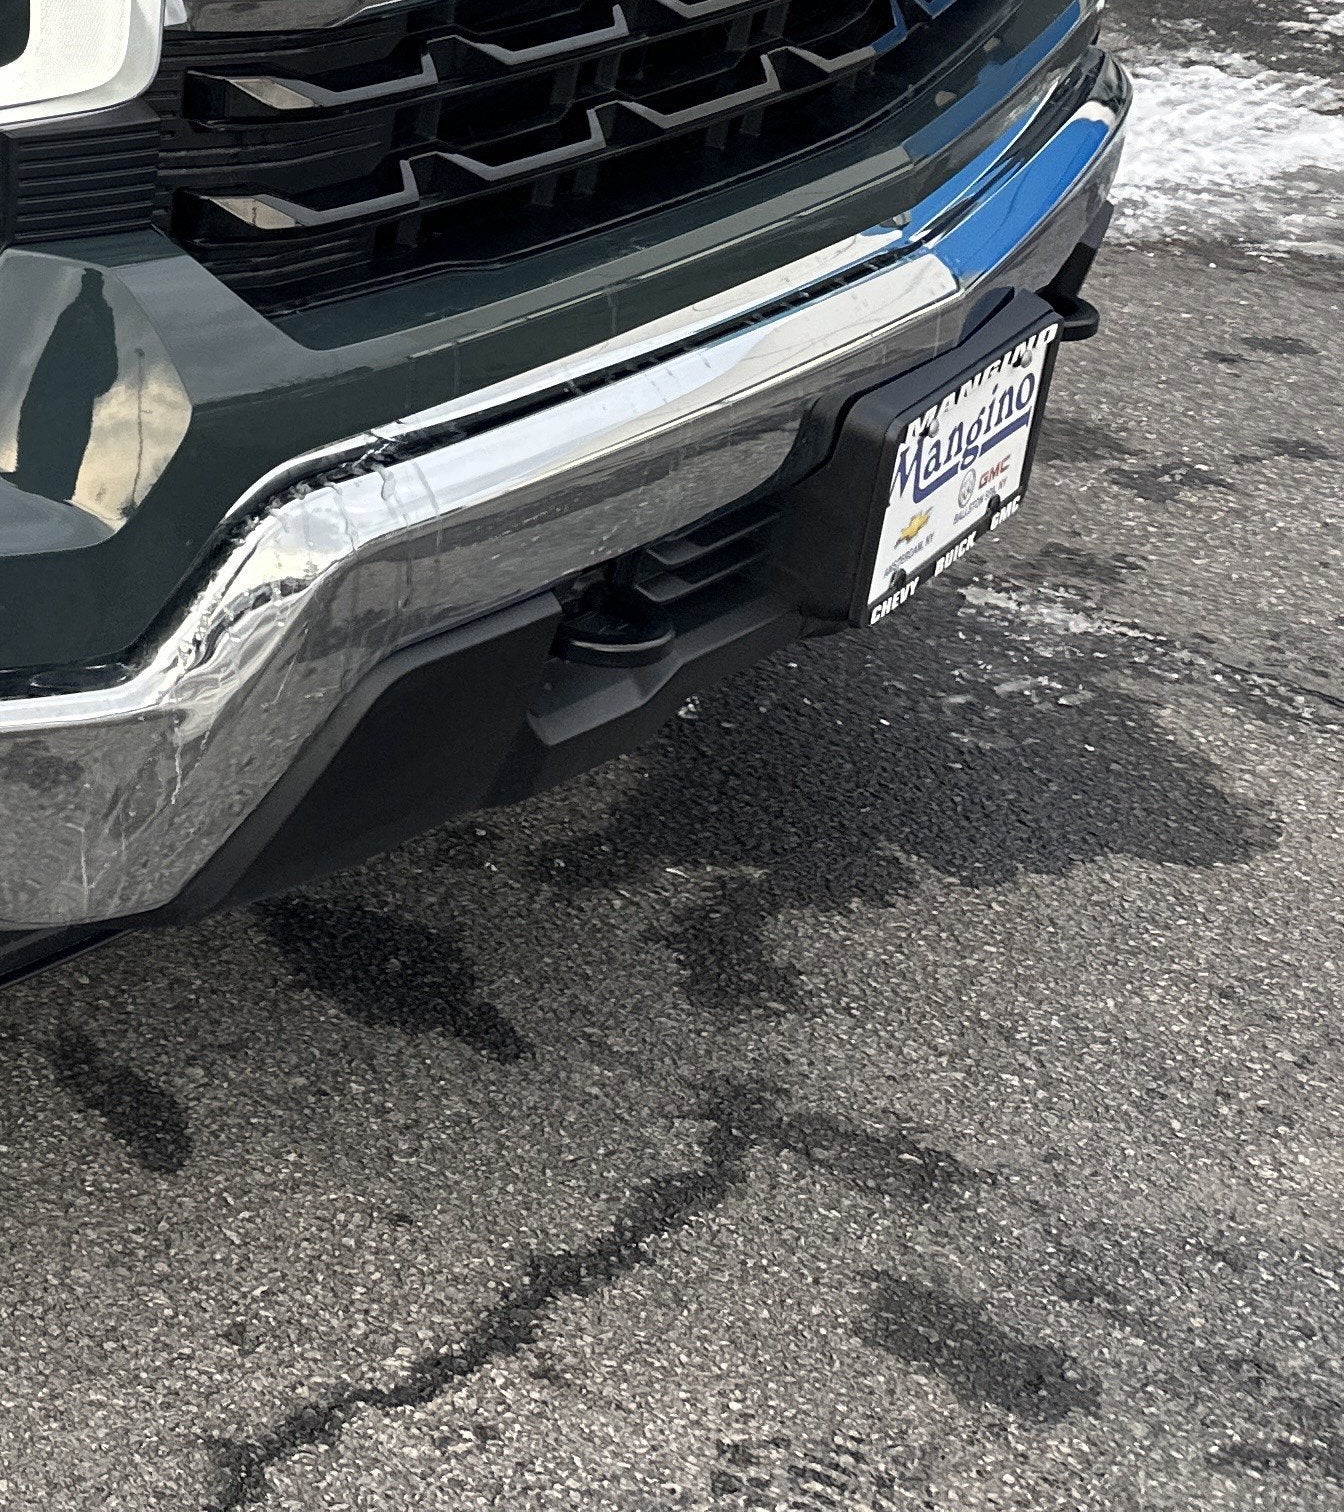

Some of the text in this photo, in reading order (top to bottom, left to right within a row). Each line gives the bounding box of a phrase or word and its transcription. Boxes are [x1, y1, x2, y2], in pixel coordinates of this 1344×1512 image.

[889, 372, 1035, 503] Mangino
[904, 323, 1058, 443] MANGINO
[977, 454, 1011, 489] GMC
[870, 495, 1021, 626] CHEVY BUICK GMC
